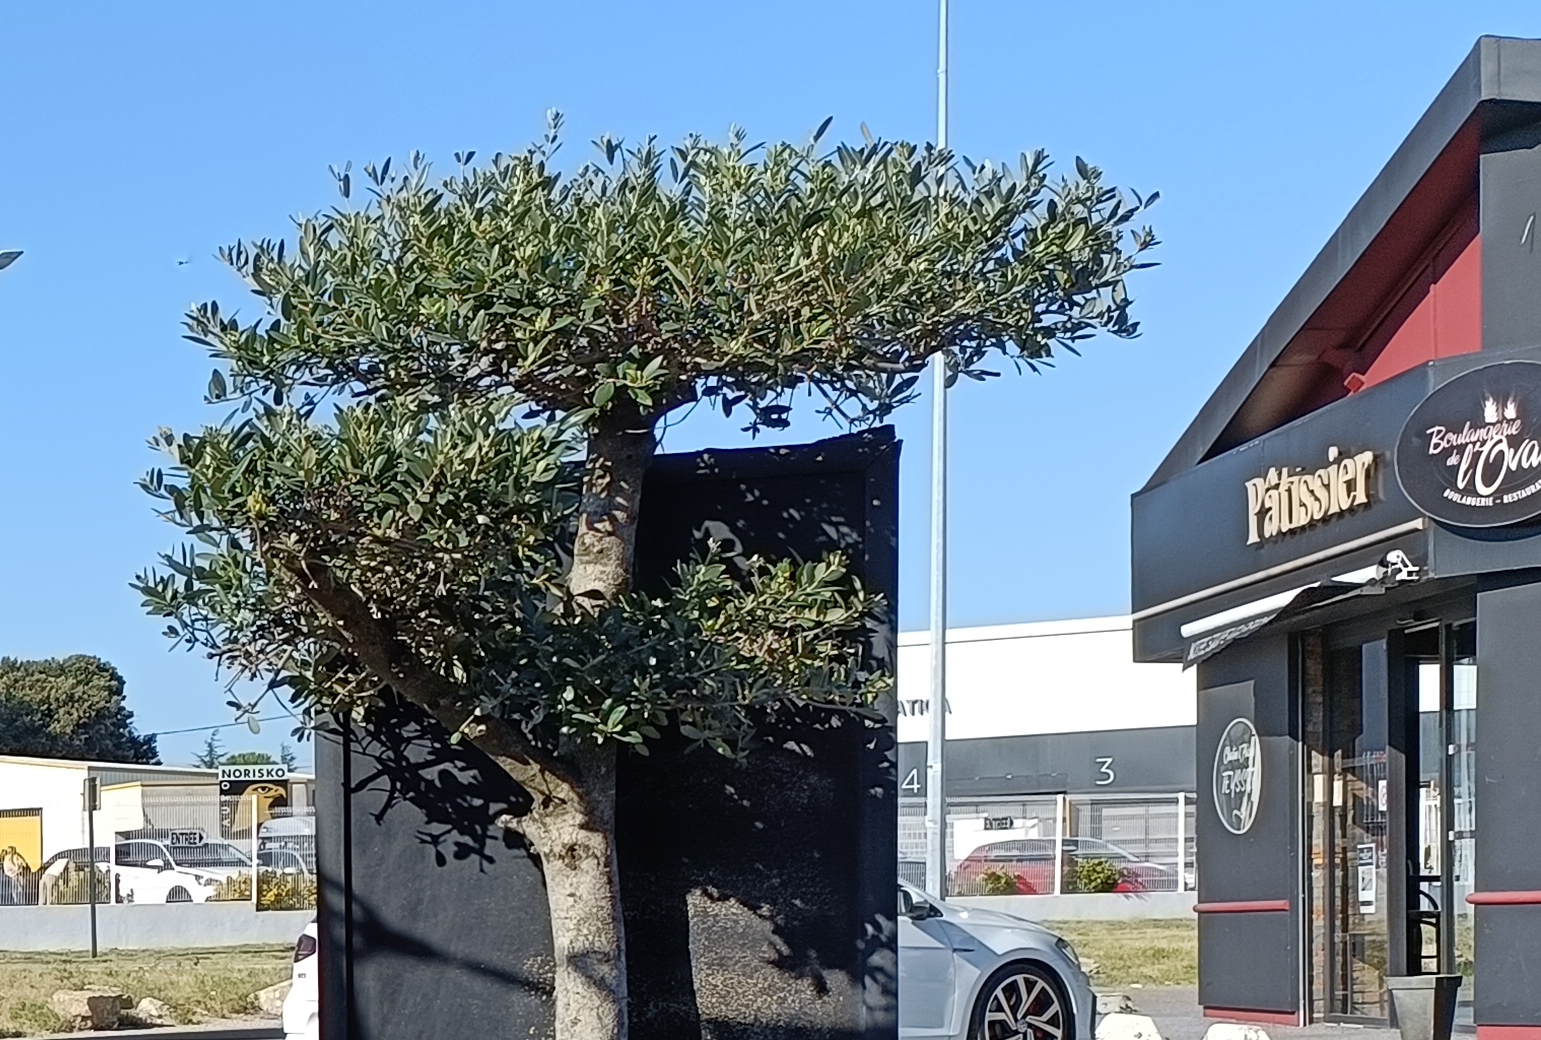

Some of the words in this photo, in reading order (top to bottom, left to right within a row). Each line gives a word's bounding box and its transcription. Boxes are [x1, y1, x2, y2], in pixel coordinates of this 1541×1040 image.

[1426, 419, 1521, 455] Boulangerie
[1446, 451, 1461, 466] de
[1245, 446, 1374, 545] Pâtissier
[1443, 487, 1494, 507] BOULANGERIE
[221, 768, 286, 779] NORISKO
[901, 768, 921, 793] 4
[1095, 757, 1115, 785] 3
